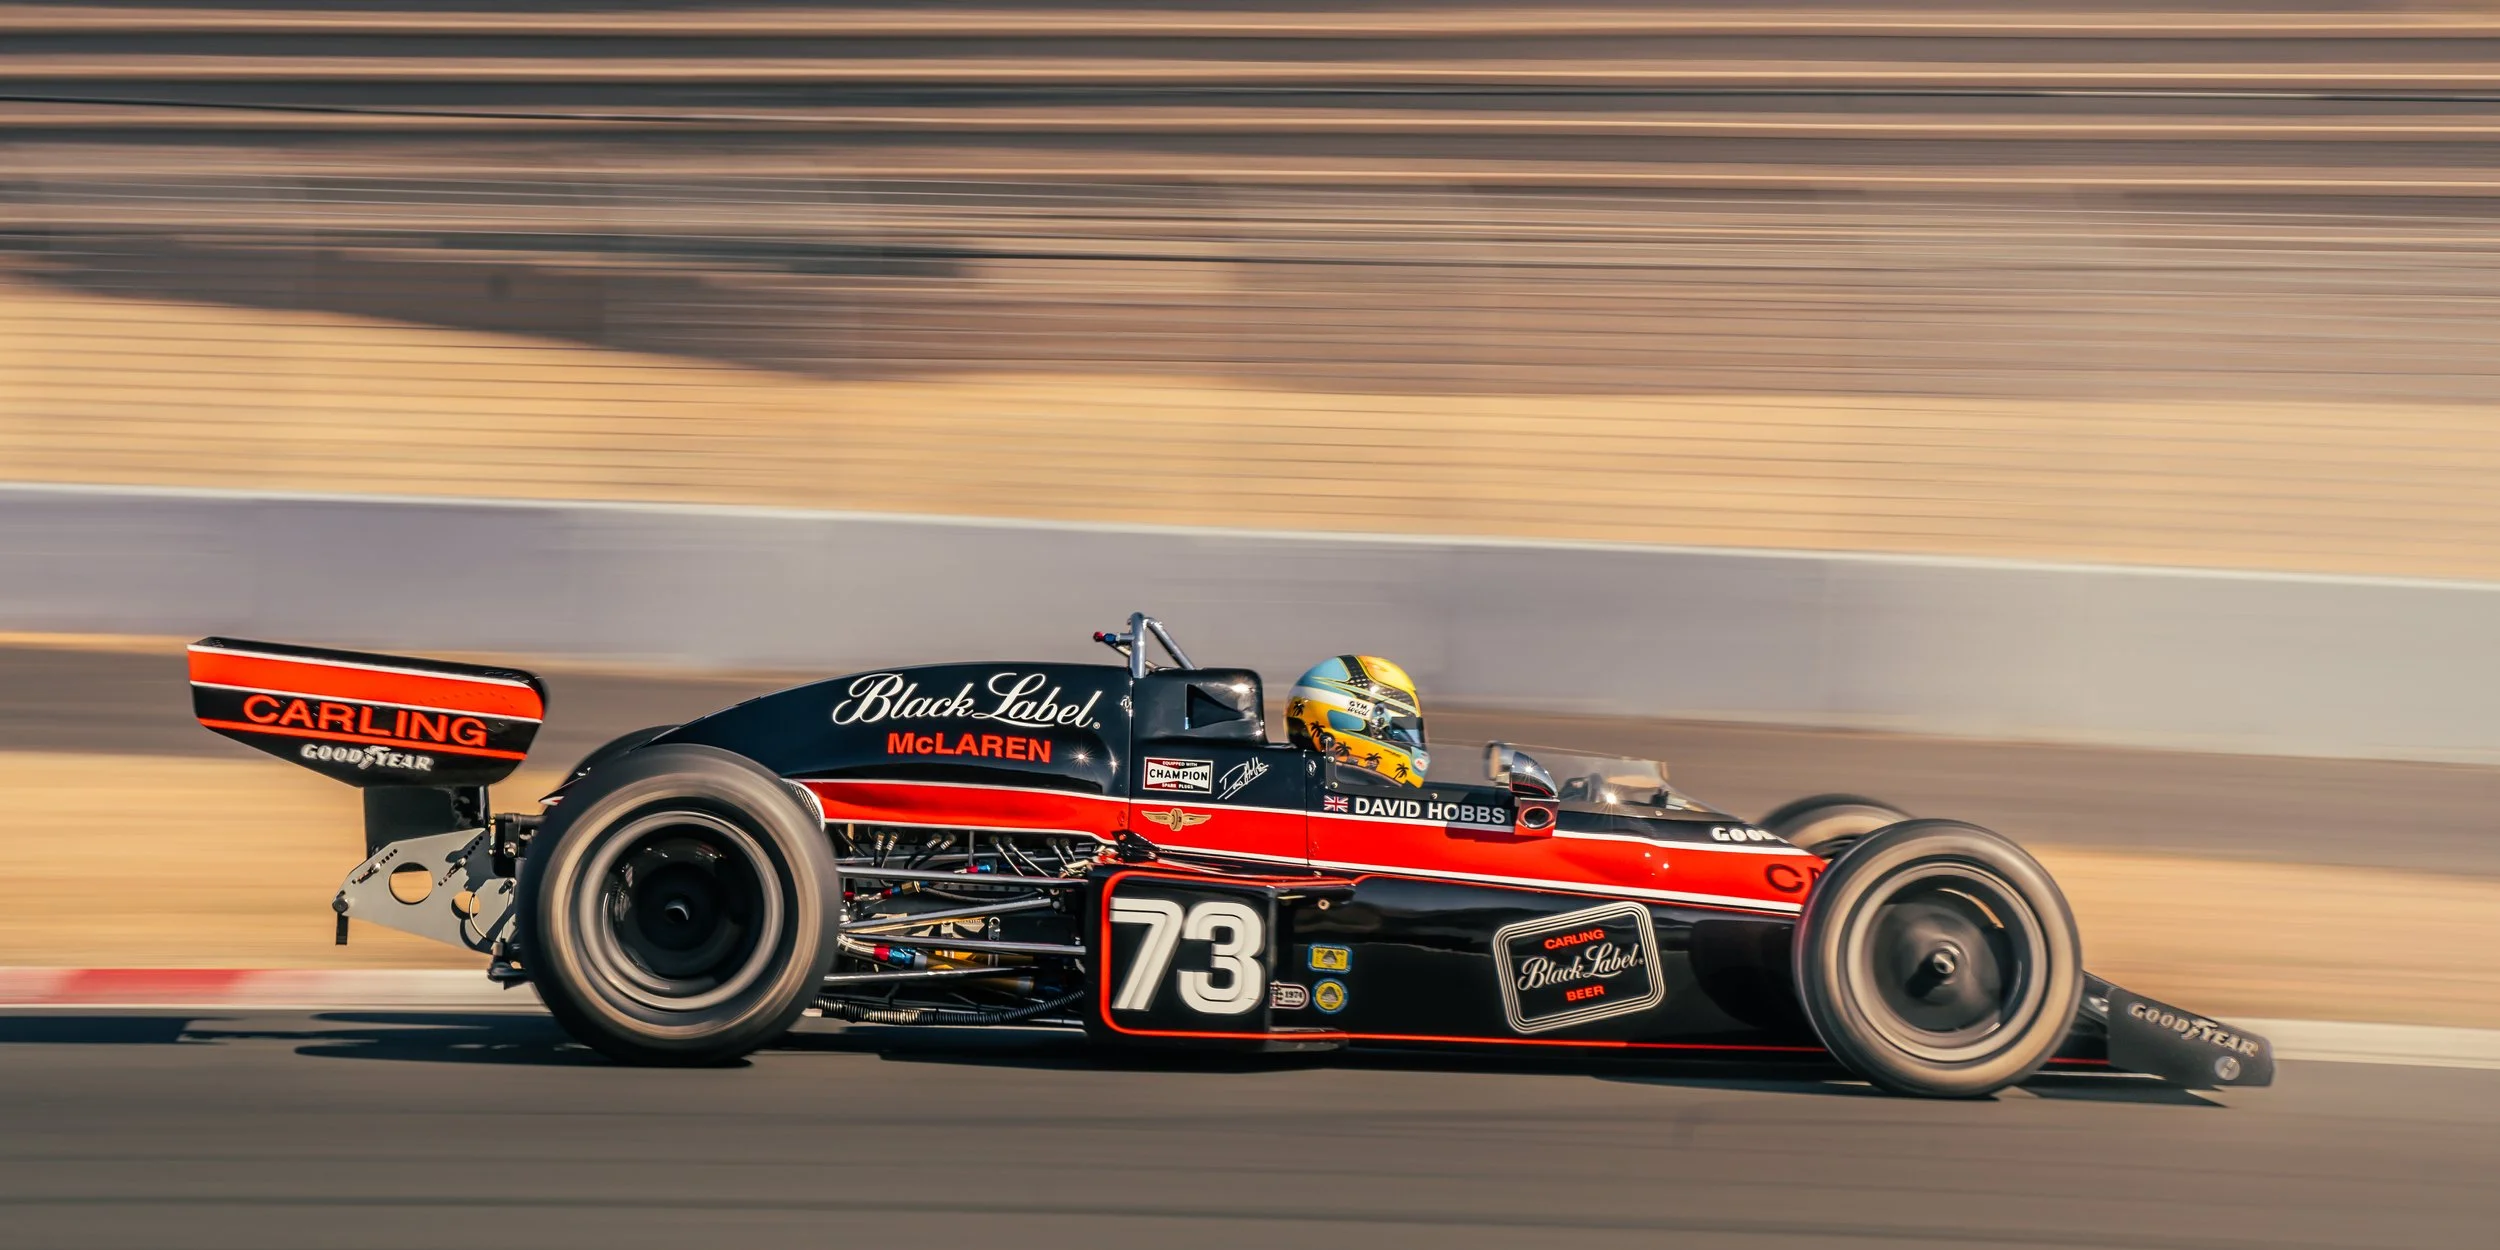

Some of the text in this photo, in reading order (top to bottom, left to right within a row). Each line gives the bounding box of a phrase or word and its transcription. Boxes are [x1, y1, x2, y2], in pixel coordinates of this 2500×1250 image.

[832, 673, 974, 725] Black
[243, 694, 488, 747] CARLING
[301, 743, 434, 771] GOODYEAR
[887, 732, 1051, 763] McLAREN
[1149, 769, 1208, 781] CHAMPION
[1355, 797, 1506, 824] DAVID HOBBS
[1109, 896, 1265, 1014] 73
[1544, 929, 1605, 950] CARLING
[1517, 956, 1584, 991] Black
[1565, 985, 1605, 1002] BEER
[2128, 1002, 2258, 1057] GOODYEAR
